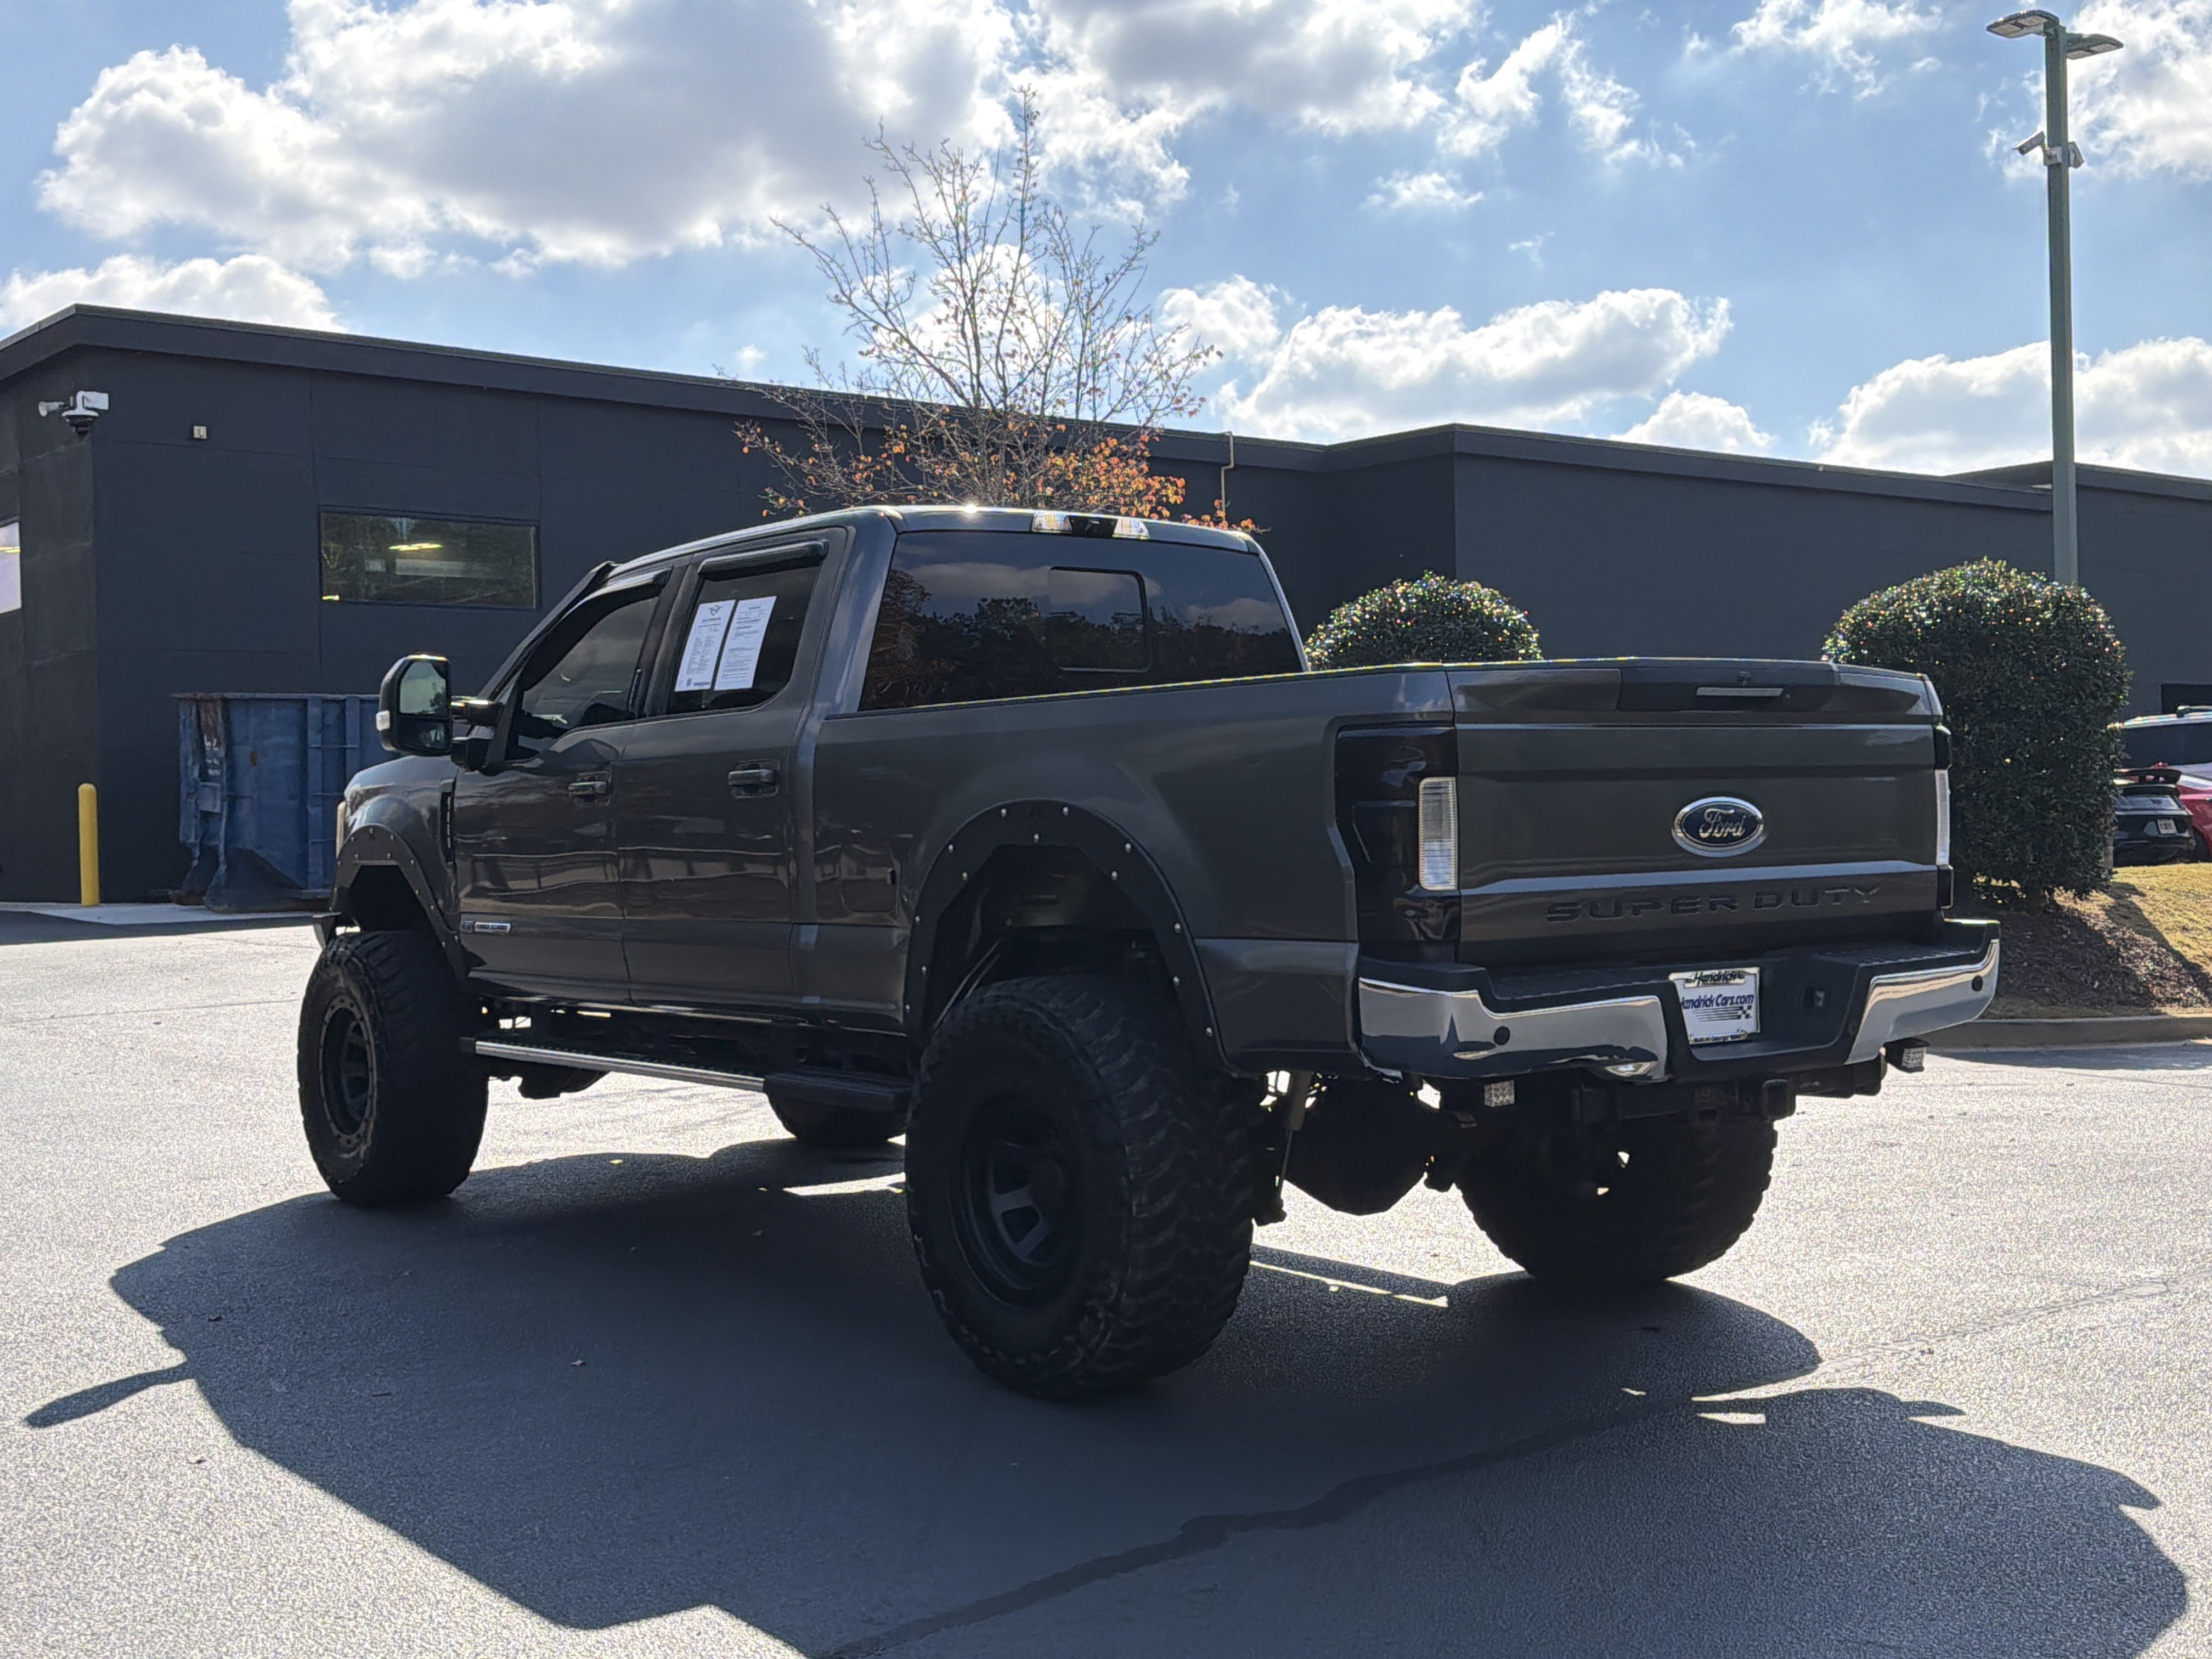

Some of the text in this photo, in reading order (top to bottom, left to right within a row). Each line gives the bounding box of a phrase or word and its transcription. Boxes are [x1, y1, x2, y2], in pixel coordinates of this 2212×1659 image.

[1699, 808, 1746, 838] Ford
[1547, 884, 1881, 922] SUPER DUTY
